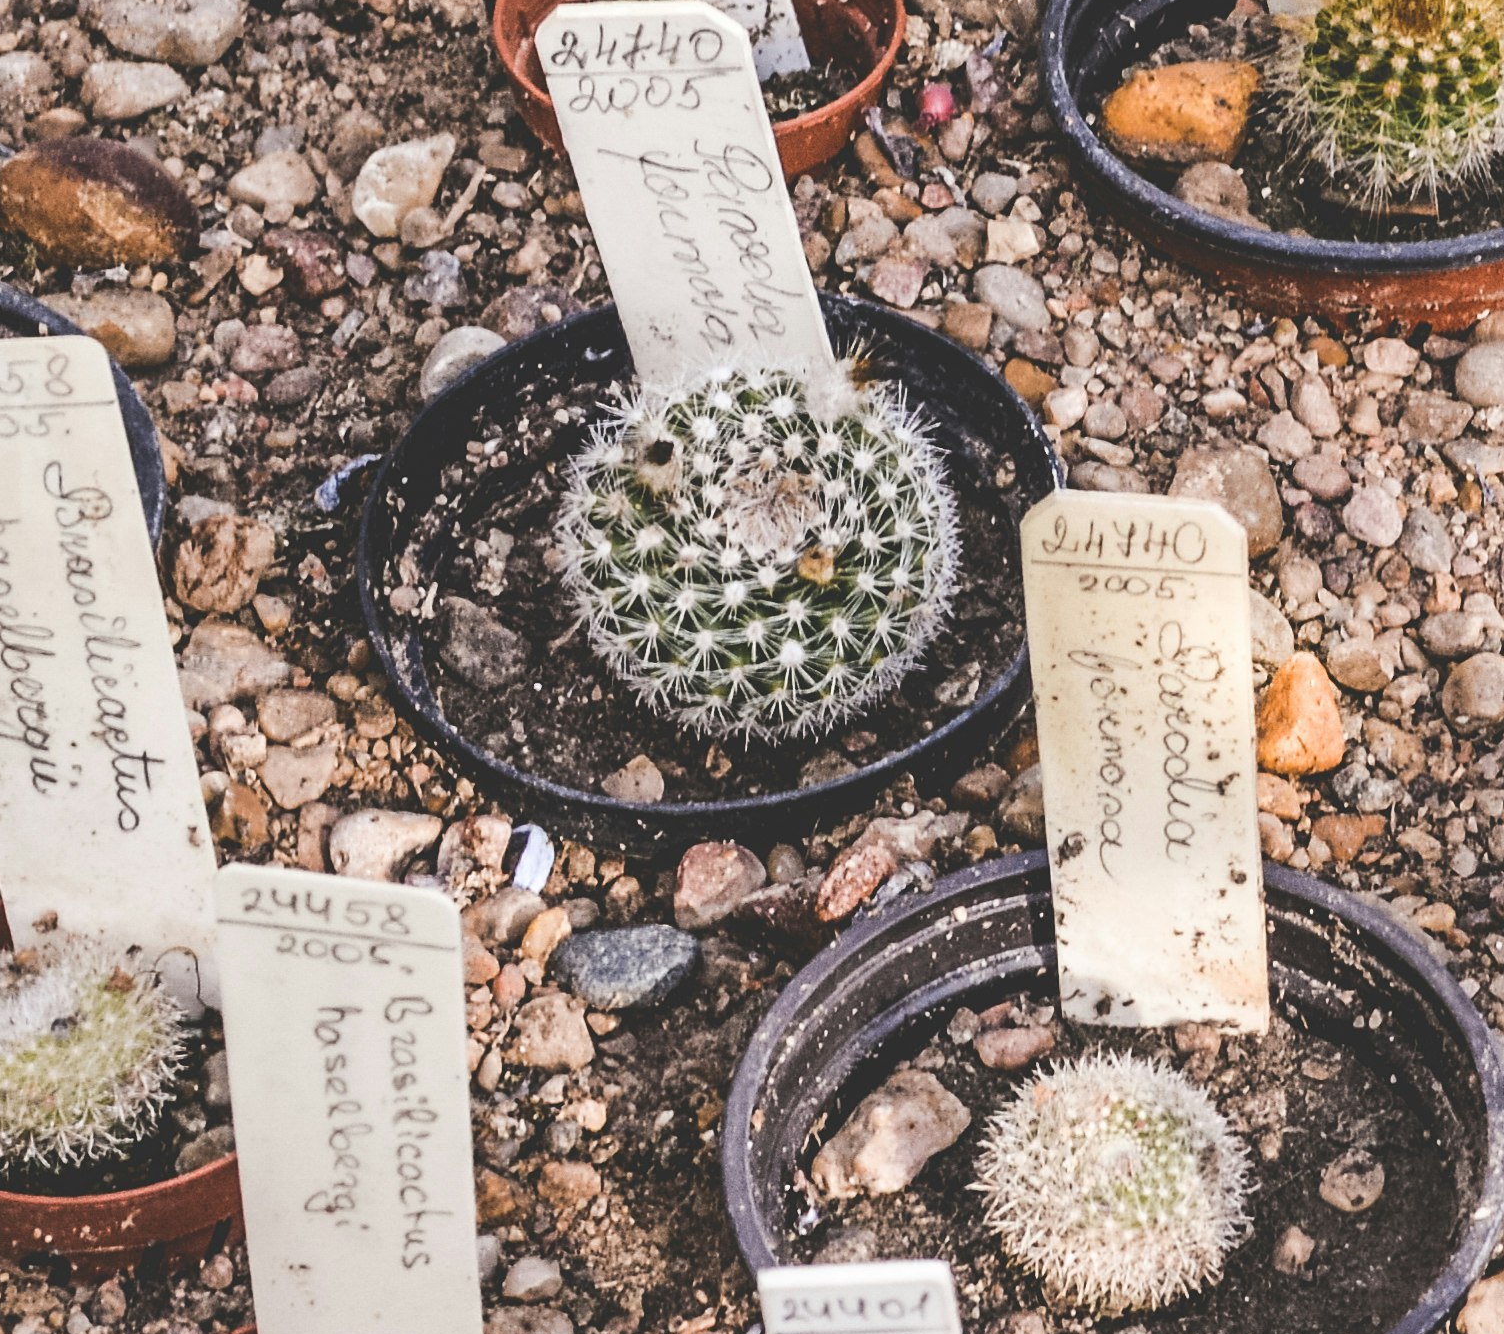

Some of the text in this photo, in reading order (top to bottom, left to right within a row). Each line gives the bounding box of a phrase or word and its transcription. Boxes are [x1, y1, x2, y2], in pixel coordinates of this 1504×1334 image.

[549, 18, 731, 71] 24740
[554, 59, 720, 119] 2005
[594, 146, 740, 354] formosa
[690, 136, 805, 342] Parodia
[1039, 513, 1208, 566] 24740
[41, 458, 167, 834] Brasilicactus
[1151, 620, 1239, 868] Parodia
[1064, 647, 1144, 878] formosa
[238, 886, 412, 936] 24458
[300, 1004, 373, 1232] haselbergi
[381, 993, 454, 1272] Brasilicactus
[780, 1289, 928, 1323] 24401
